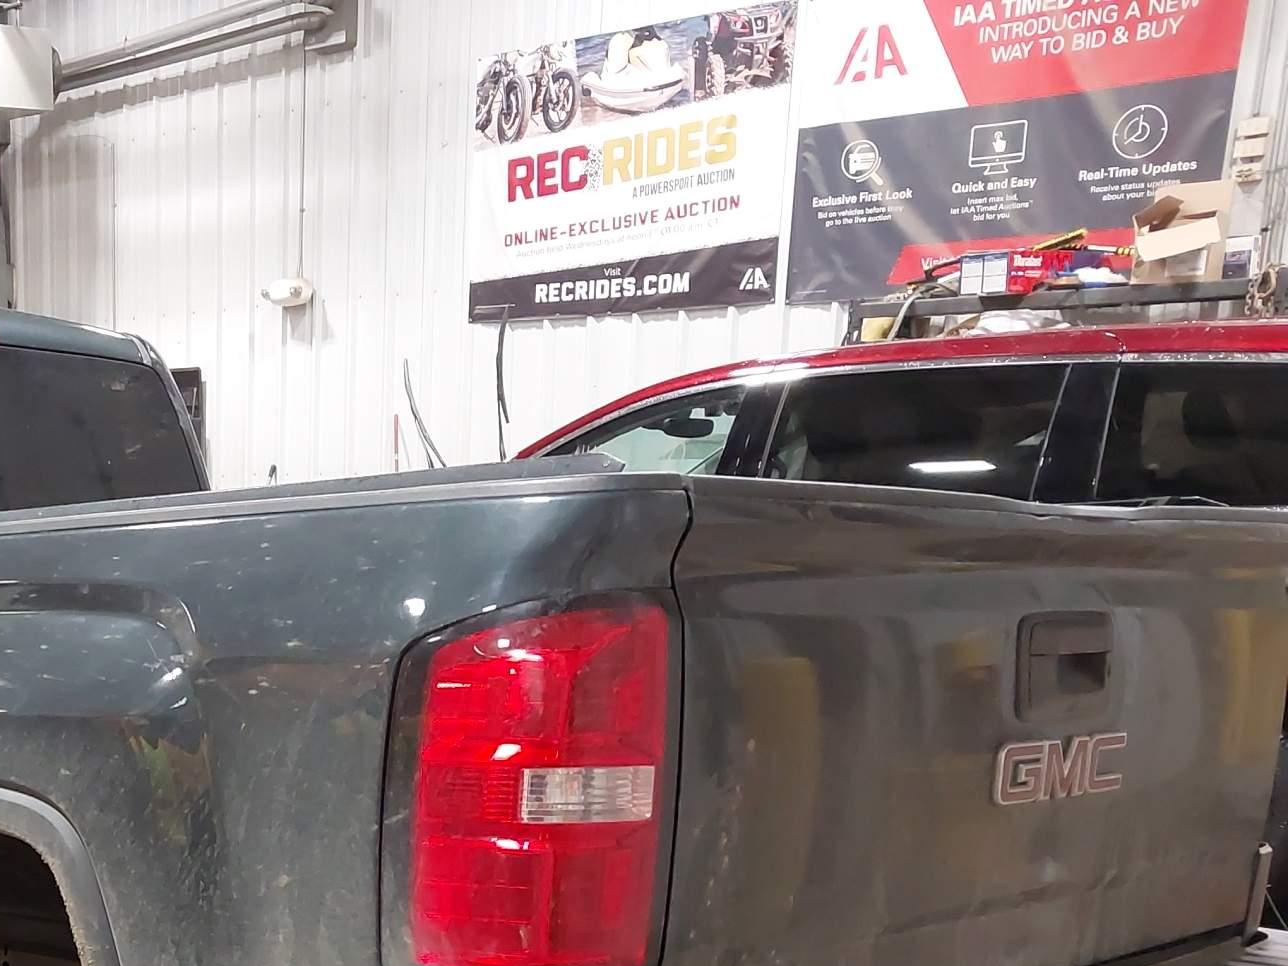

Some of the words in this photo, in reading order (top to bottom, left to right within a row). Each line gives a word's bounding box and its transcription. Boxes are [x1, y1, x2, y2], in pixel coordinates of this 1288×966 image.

[954, 1, 996, 27] IAA
[978, 4, 1119, 43] INTRODUCING
[1124, 0, 1141, 20] A
[991, 41, 1034, 64] WAY
[1039, 37, 1065, 56] TO
[1072, 29, 1107, 52] BID
[1112, 26, 1129, 45] &
[1136, 16, 1184, 42] BUY
[508, 145, 590, 203] REC
[602, 114, 737, 186] RIDES
[1078, 166, 1139, 182] Real-Time
[1142, 160, 1198, 176] Updates
[632, 186, 638, 199] A
[639, 175, 694, 197] POWERSPORT
[697, 168, 735, 186] AUCTION
[951, 181, 985, 194] Quick
[987, 179, 1008, 191] and
[1010, 177, 1038, 190] Easy
[1090, 183, 1120, 193] Receive
[1120, 181, 1145, 191] status
[812, 193, 858, 208] Exclusive
[859, 191, 883, 203] First
[885, 188, 913, 200] Look
[967, 197, 988, 205] Insert
[1102, 192, 1124, 201] about
[1126, 191, 1144, 200] your
[817, 211, 827, 219] Bid
[838, 208, 864, 217] vehicles
[865, 206, 886, 214] before
[868, 214, 892, 222] auction
[961, 206, 976, 214] IAA
[973, 213, 985, 221] bid
[996, 212, 1011, 221] you
[504, 209, 659, 247] ONLINE-EXCLUSIVE
[664, 195, 741, 222] AUCTION
[603, 267, 622, 277] Visit
[534, 272, 691, 303] RECRIDES.COM
[992, 732, 1127, 806] GMC
